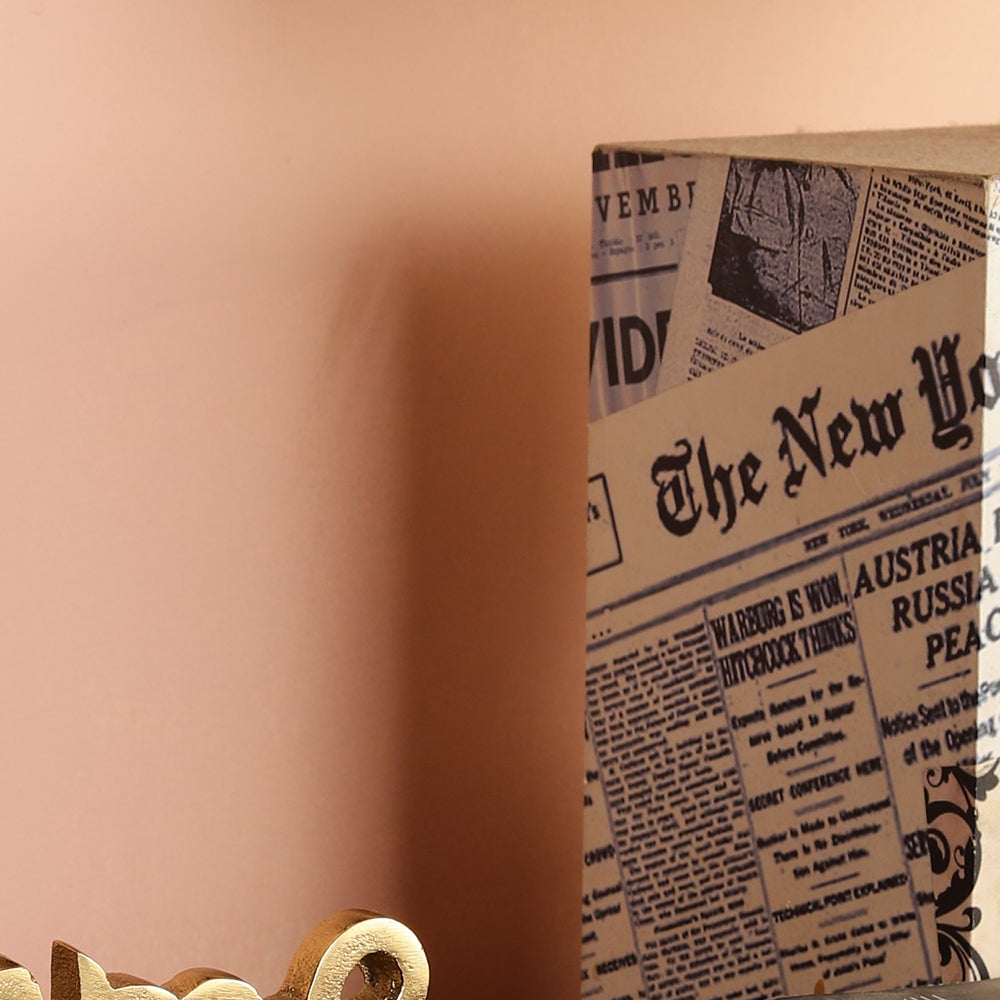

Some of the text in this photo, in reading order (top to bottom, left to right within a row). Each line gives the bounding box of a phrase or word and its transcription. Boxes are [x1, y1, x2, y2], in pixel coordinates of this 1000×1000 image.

[651, 333, 1000, 537] The New Yo
[853, 521, 982, 599] AUSTRIA
[787, 588, 804, 621] IS
[892, 565, 999, 633] RUSSIA
[799, 611, 857, 659] THINKS
